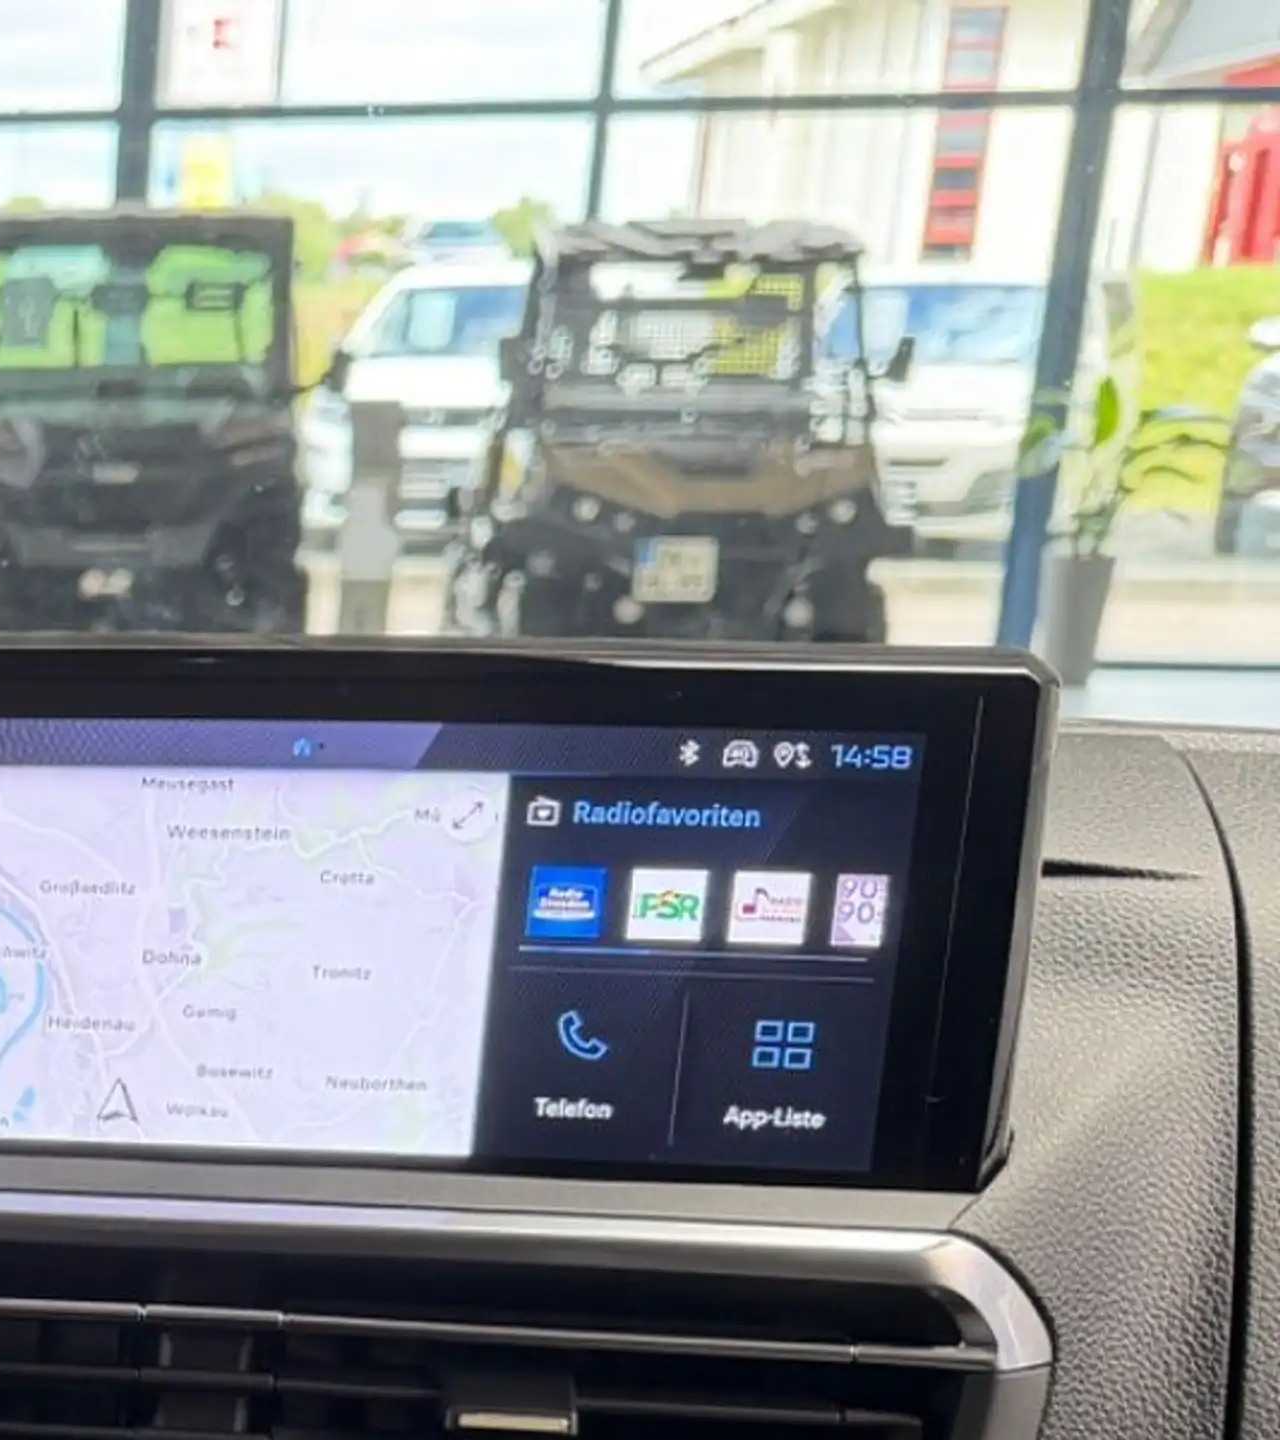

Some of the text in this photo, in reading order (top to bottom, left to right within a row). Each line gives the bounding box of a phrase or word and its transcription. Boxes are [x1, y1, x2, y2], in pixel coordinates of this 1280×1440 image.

[830, 744, 913, 769] 14:58
[141, 776, 235, 793] Meusegast
[572, 801, 762, 828] Radiofavoriten
[166, 824, 290, 842] Weesenstein
[142, 950, 202, 966] Dohna
[313, 965, 372, 981] Tronitz
[49, 1016, 136, 1033] Heidenau
[325, 1075, 428, 1093] Neuborthen
[534, 1097, 614, 1121] Telefon
[723, 1106, 827, 1130] App-Liste
